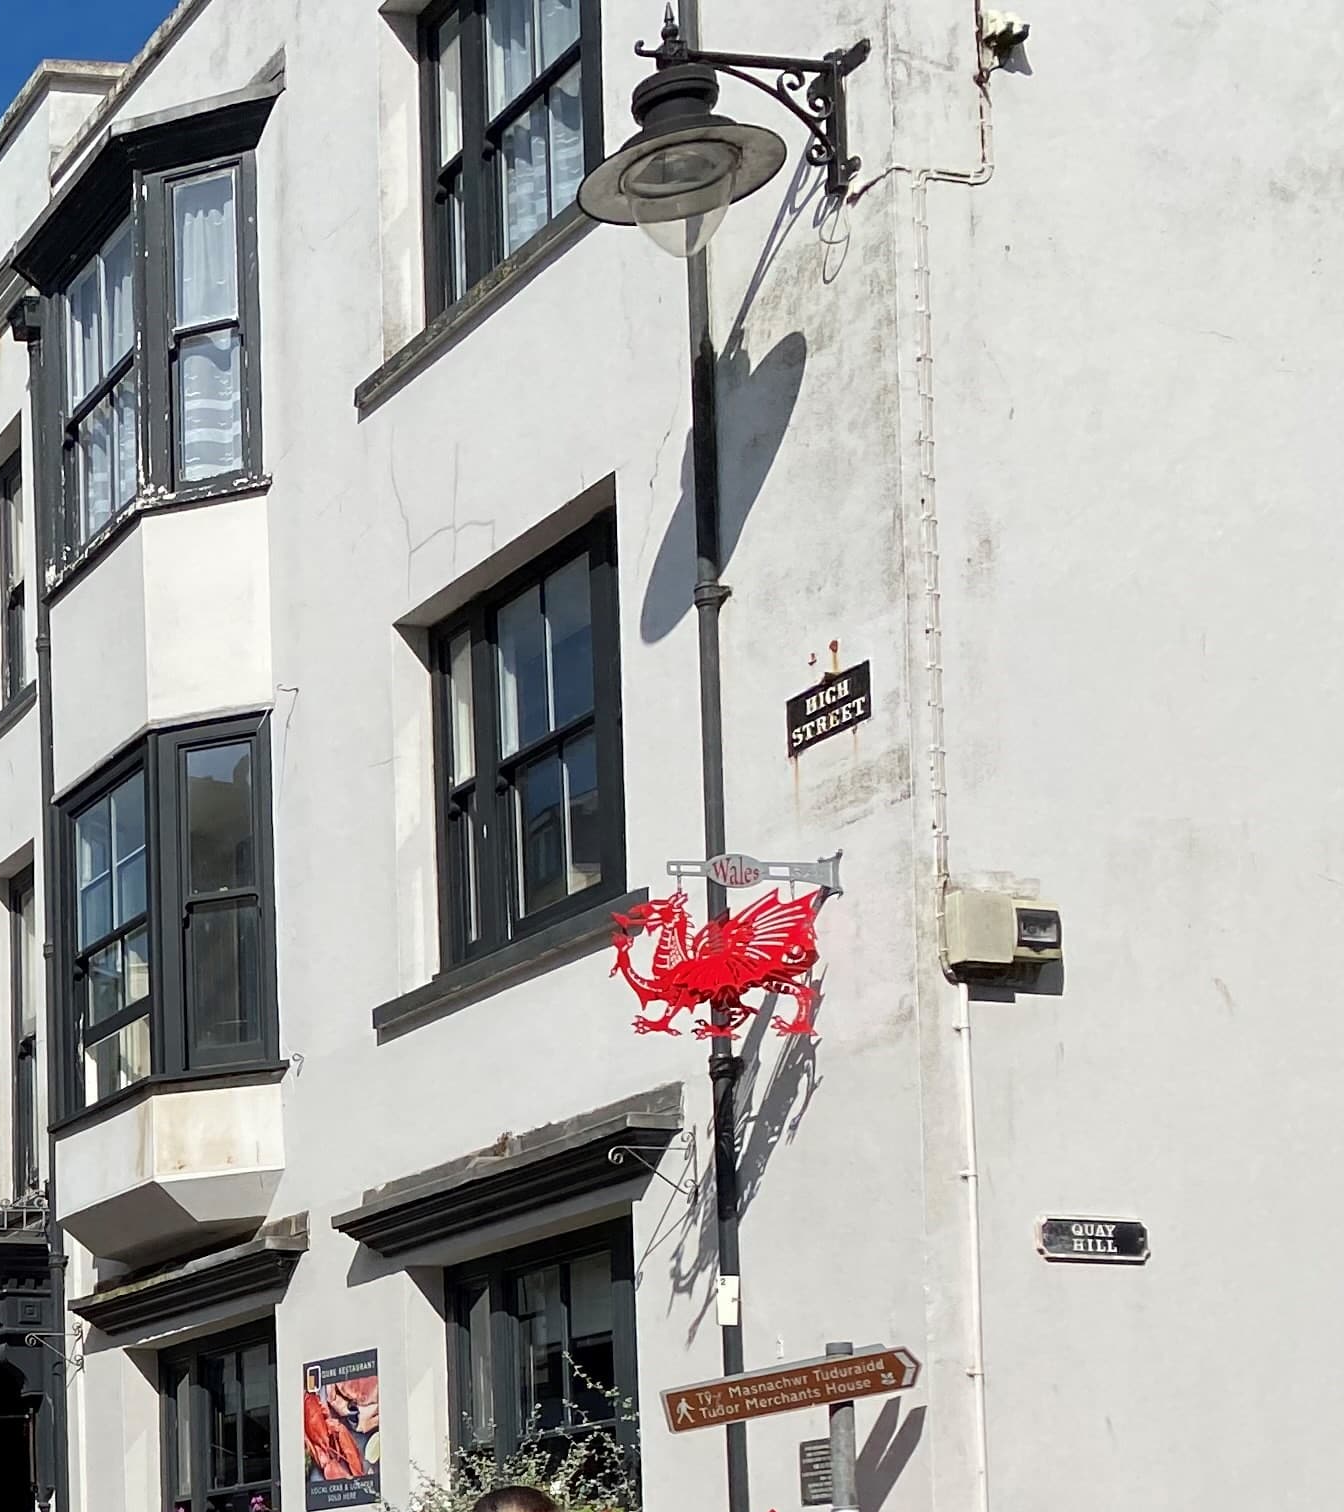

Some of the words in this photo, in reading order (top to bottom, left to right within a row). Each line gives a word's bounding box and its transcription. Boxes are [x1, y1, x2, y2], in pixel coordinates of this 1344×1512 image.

[805, 679, 849, 716] HIGH
[792, 696, 866, 747] STREET
[712, 856, 760, 885] Wales
[1071, 1223, 1116, 1238] QUAY
[1071, 1238, 1118, 1253] HILL
[728, 1375, 809, 1399] Masnachwr
[813, 1359, 885, 1382] Tuduraidd
[699, 1402, 741, 1420] Tudor
[745, 1386, 821, 1411] Merchants
[826, 1378, 872, 1395] House
